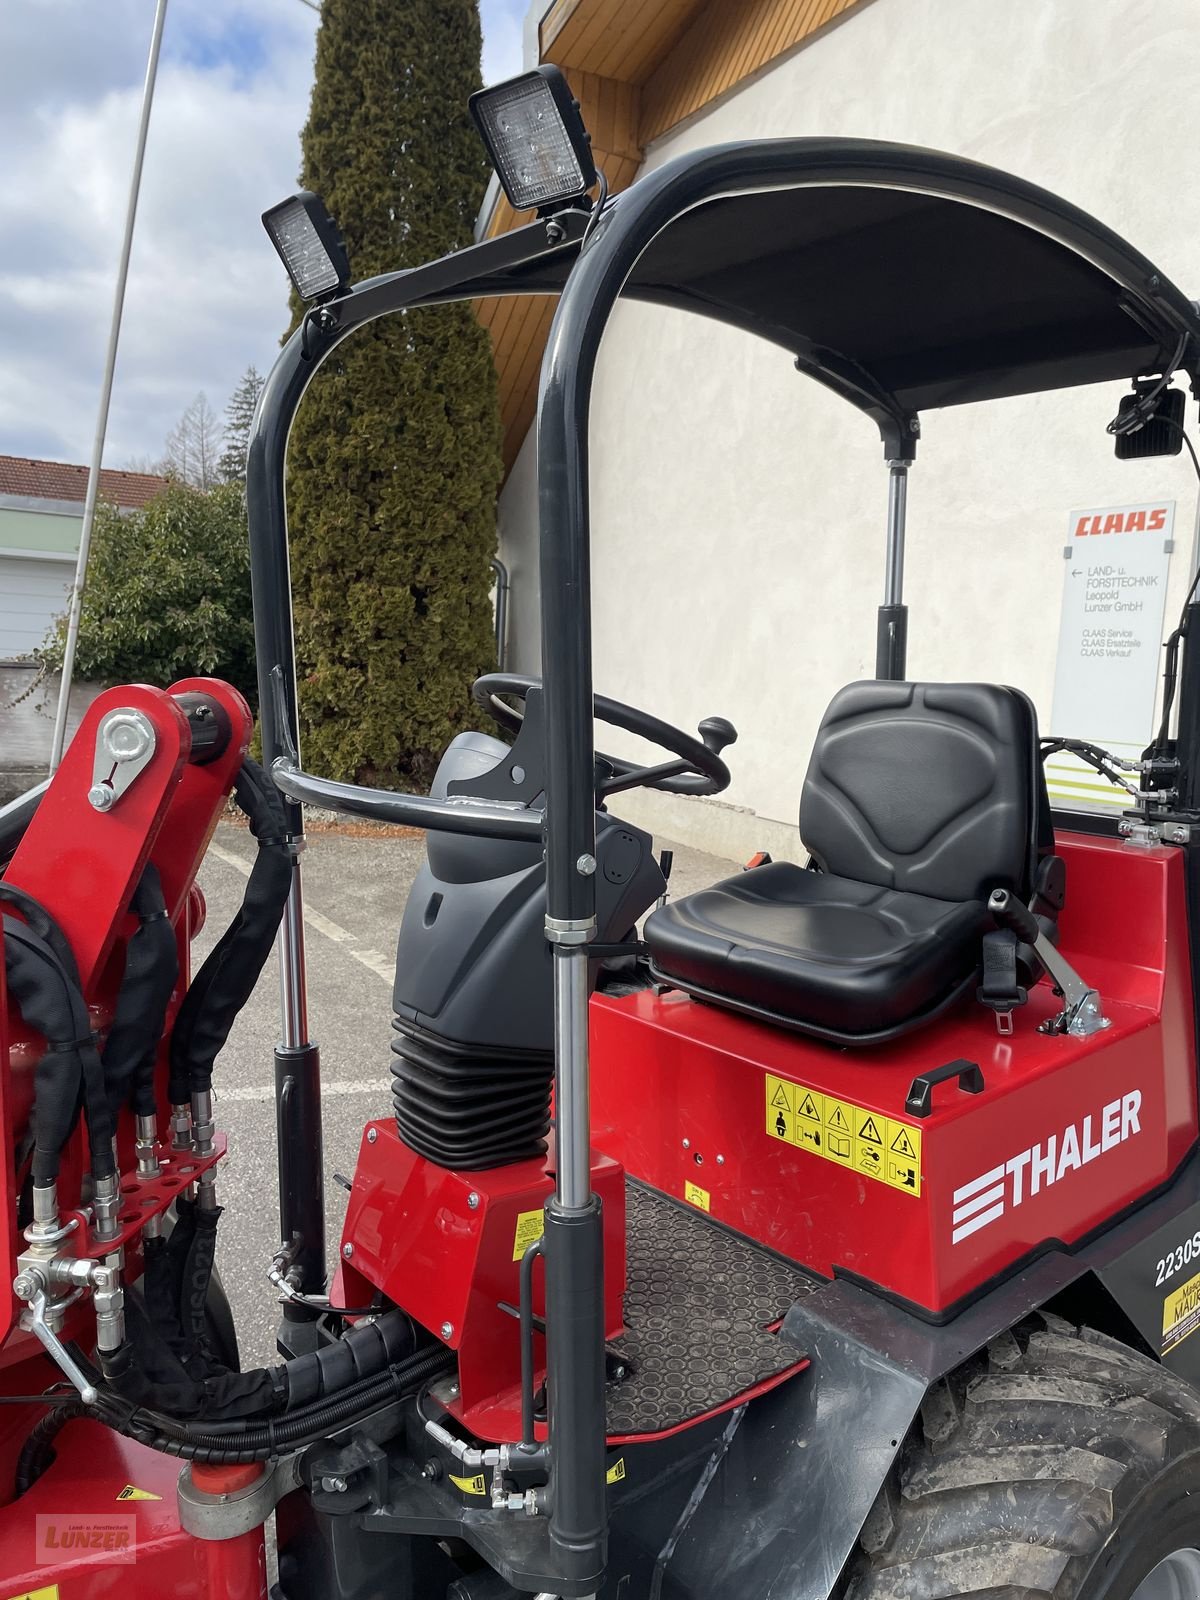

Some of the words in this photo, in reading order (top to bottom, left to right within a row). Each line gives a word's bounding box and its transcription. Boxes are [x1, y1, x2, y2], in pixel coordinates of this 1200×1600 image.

[1075, 509, 1167, 536] CLAAS
[1088, 566, 1116, 576] LAND-
[1087, 576, 1158, 588] FORSTTECHNIK
[1086, 591, 1119, 602] Leopold
[1085, 603, 1112, 612] Lunzer
[1114, 602, 1143, 612] GmbH
[1082, 629, 1106, 637] CLAAS
[1107, 629, 1133, 638] Service
[1081, 639, 1105, 647] CLAAS
[1107, 639, 1141, 648] Ersatzteile
[1080, 649, 1104, 657] CLAAS
[1105, 649, 1131, 657] Verkauf
[1006, 1089, 1142, 1207] THALER
